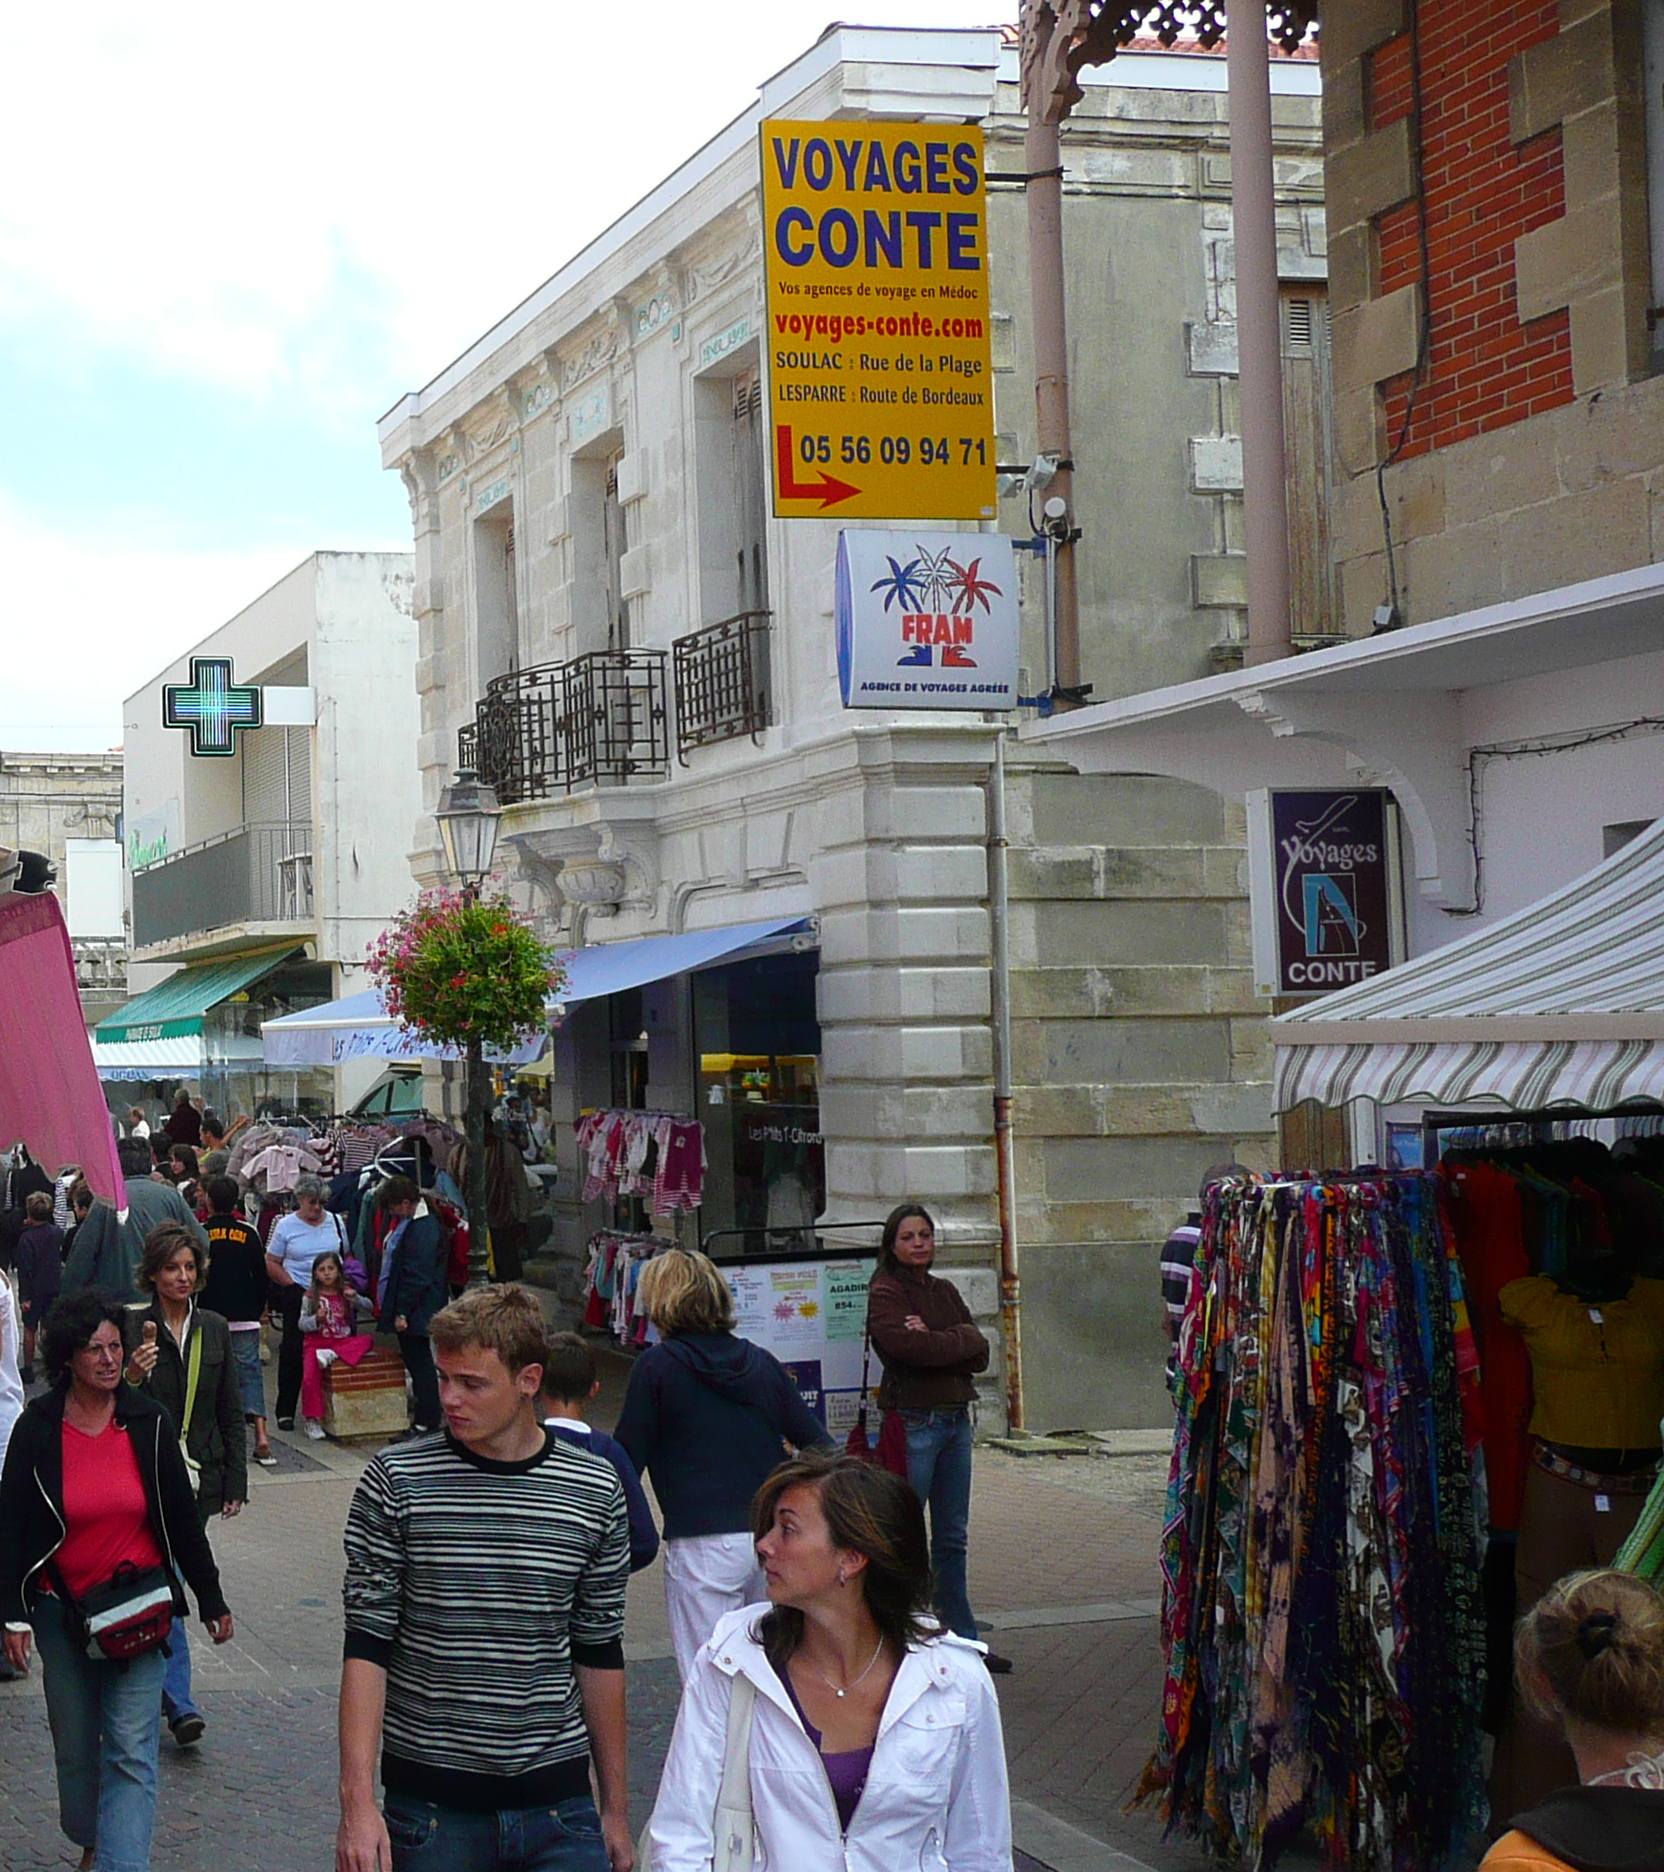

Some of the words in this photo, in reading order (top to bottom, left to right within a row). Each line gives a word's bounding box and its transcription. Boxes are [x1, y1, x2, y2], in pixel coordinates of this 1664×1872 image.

[772, 137, 979, 196] VOYAGES
[775, 206, 981, 271] CONTE
[778, 281, 800, 295] Vos
[804, 284, 853, 299] agences
[856, 282, 871, 296] de
[874, 286, 916, 301] voyage
[920, 286, 935, 299] en
[939, 284, 978, 300] Médoc
[775, 311, 983, 344] voyages-conte.com
[776, 351, 843, 371] SOULAC
[859, 353, 890, 372] Rue
[895, 353, 915, 372] de
[919, 354, 933, 373] la
[938, 355, 983, 378] Plage
[779, 384, 847, 403] LESPARRE
[859, 386, 898, 404] Route
[902, 386, 918, 405] de
[922, 387, 984, 406] Bordeaux
[800, 434, 832, 464] 05
[841, 435, 872, 464] 56
[880, 436, 911, 465] 09
[919, 437, 950, 466] 94
[959, 438, 986, 466] 71
[901, 613, 973, 646] FRAM
[860, 681, 902, 693] AGENCE
[903, 682, 918, 692] DE
[920, 682, 967, 693] VOYAGES
[969, 680, 1010, 694] AGRÉÉE
[1281, 834, 1378, 871] Voyages
[1288, 961, 1377, 983] CONTE
[830, 1283, 870, 1294] AGADIR
